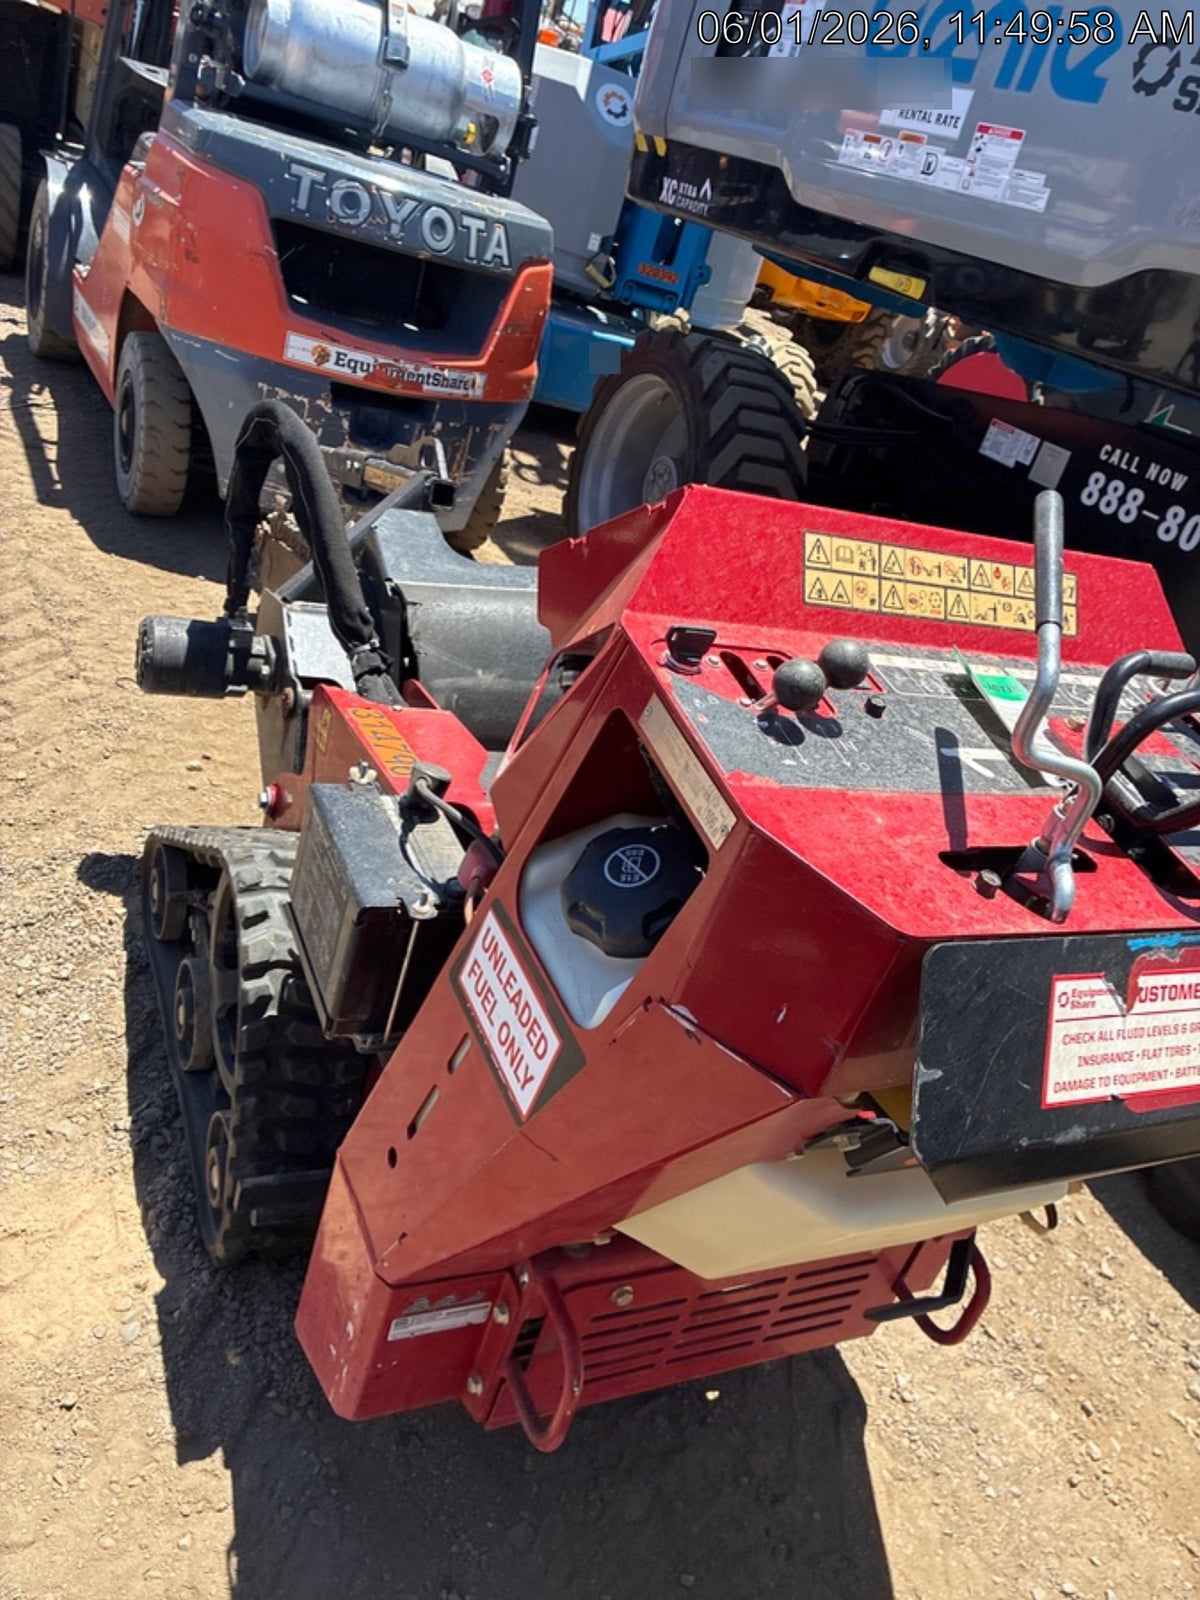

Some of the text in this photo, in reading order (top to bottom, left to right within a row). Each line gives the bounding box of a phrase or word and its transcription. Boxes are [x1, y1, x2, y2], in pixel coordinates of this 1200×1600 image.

[897, 109, 961, 129] RENTAL RATE
[659, 176, 678, 206] XC
[289, 162, 512, 270] TOYOTA
[1099, 444, 1139, 474] CALL
[1145, 462, 1189, 492] NOW
[1080, 471, 1200, 551] 888-80
[481, 927, 549, 1061] UNLEADED
[1070, 1000, 1097, 1010] Share
[1138, 982, 1200, 1003] USTOME
[467, 958, 535, 1092] FUEL ONLY
[1062, 1031, 1096, 1046] CHECK
[1098, 1029, 1115, 1042] ALL
[1116, 1027, 1145, 1040] FLUID
[1146, 1023, 1179, 1037] LEVELS
[1077, 1050, 1134, 1068] INSURANCE
[1141, 1047, 1163, 1060] FLAT
[1164, 1044, 1191, 1058] TIRES
[1053, 1076, 1096, 1094] DAMAGE
[1099, 1075, 1111, 1088] TO
[1112, 1068, 1168, 1086] EQUIPMENT
